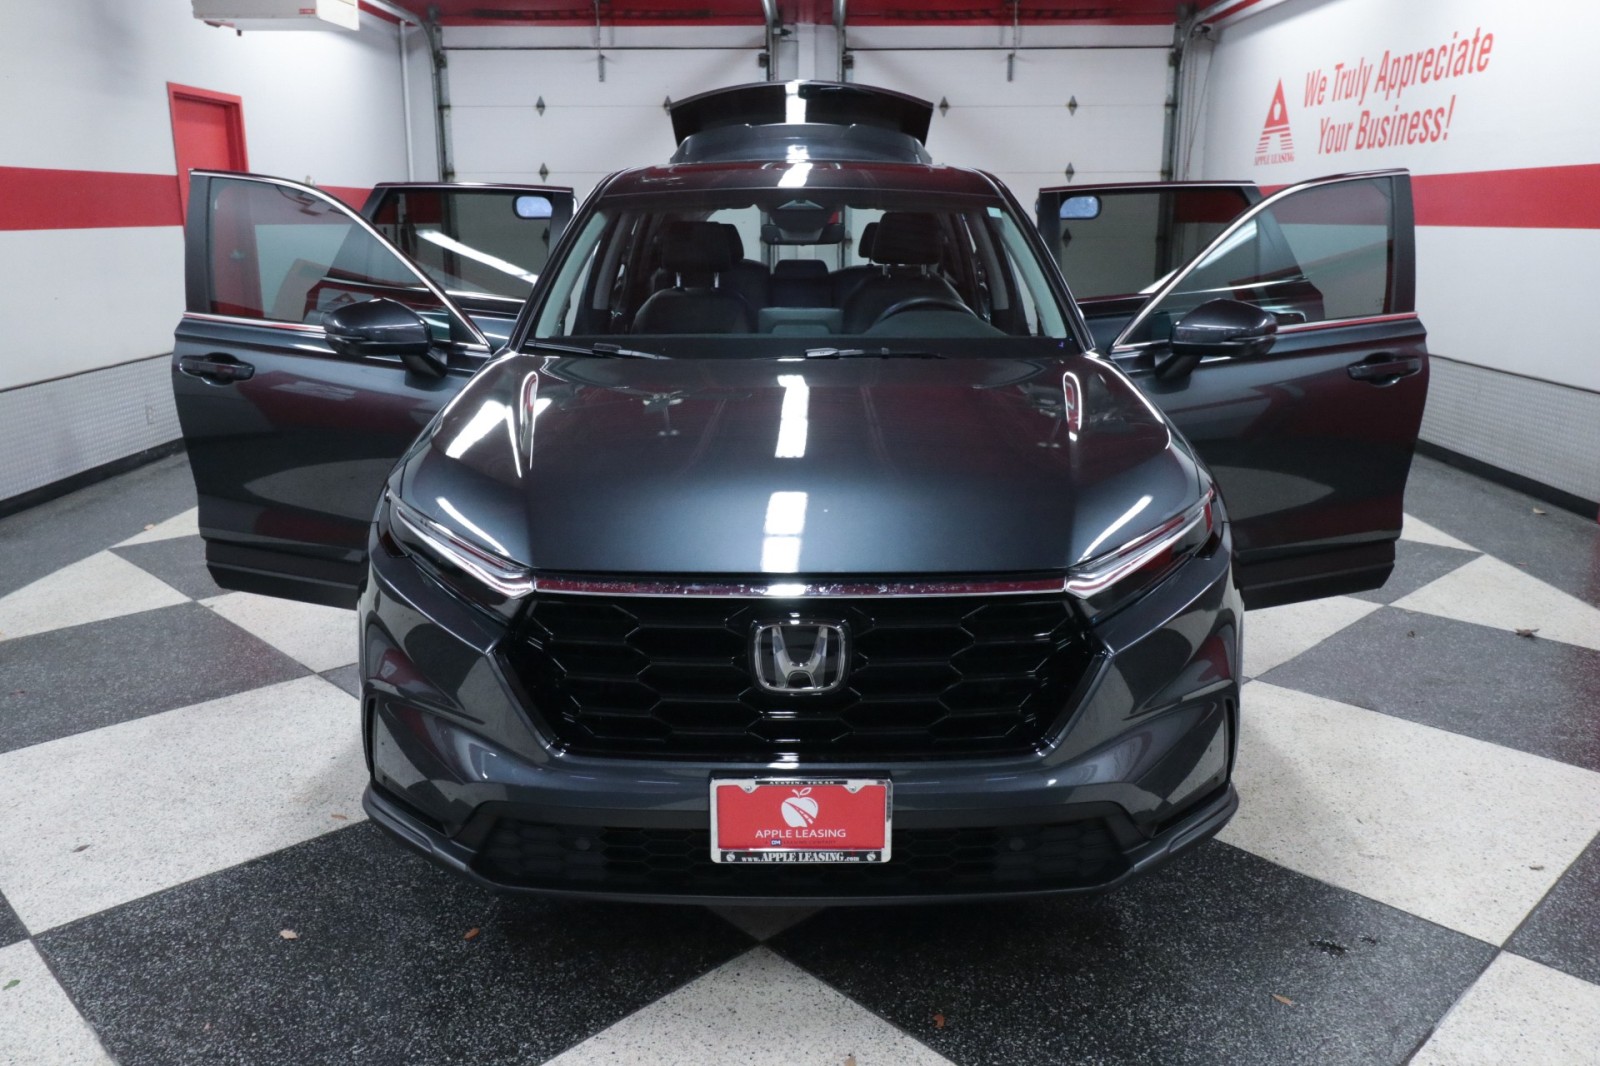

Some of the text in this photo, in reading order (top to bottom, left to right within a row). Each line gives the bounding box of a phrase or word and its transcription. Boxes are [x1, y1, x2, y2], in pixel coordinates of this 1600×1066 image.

[1304, 27, 1494, 108] We Truly Appreciate
[1318, 94, 1456, 154] Your Business!
[755, 829, 846, 838] APPLE LEASING
